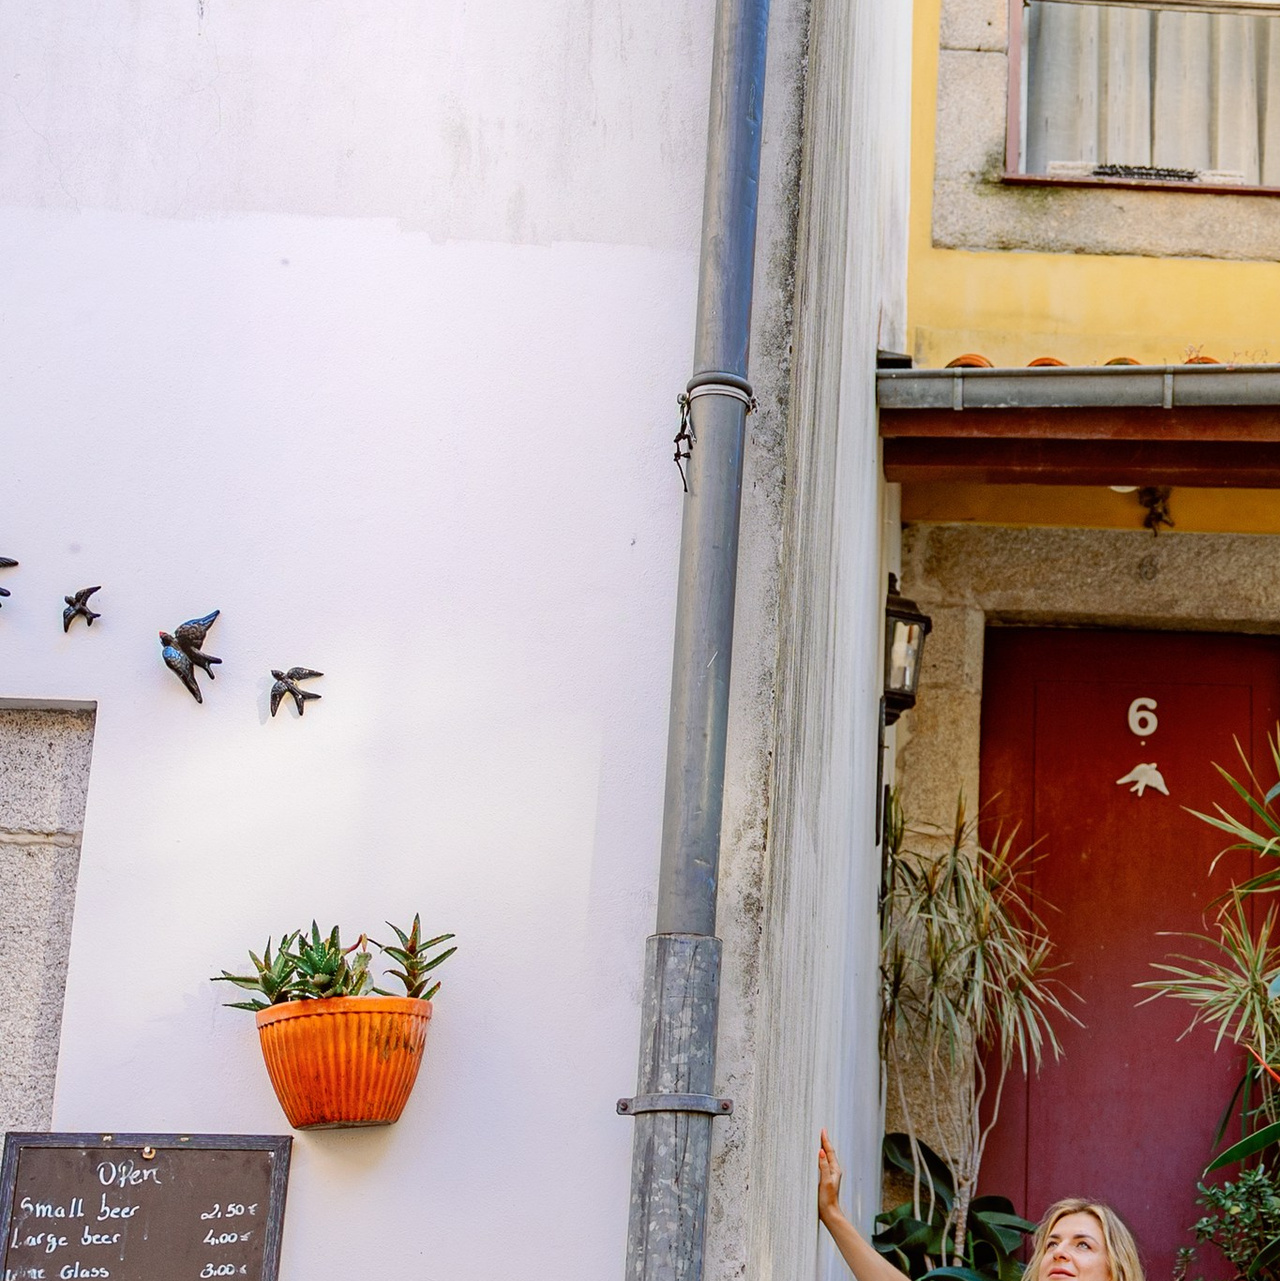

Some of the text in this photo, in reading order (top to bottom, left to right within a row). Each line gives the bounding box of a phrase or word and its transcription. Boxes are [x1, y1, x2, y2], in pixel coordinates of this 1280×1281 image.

[1128, 697, 1158, 736] 6
[20, 1196, 85, 1218] Small
[97, 1192, 140, 1220] beer
[11, 1227, 68, 1253] Large
[81, 1225, 121, 1245] beer
[60, 1261, 110, 1280] Glass
